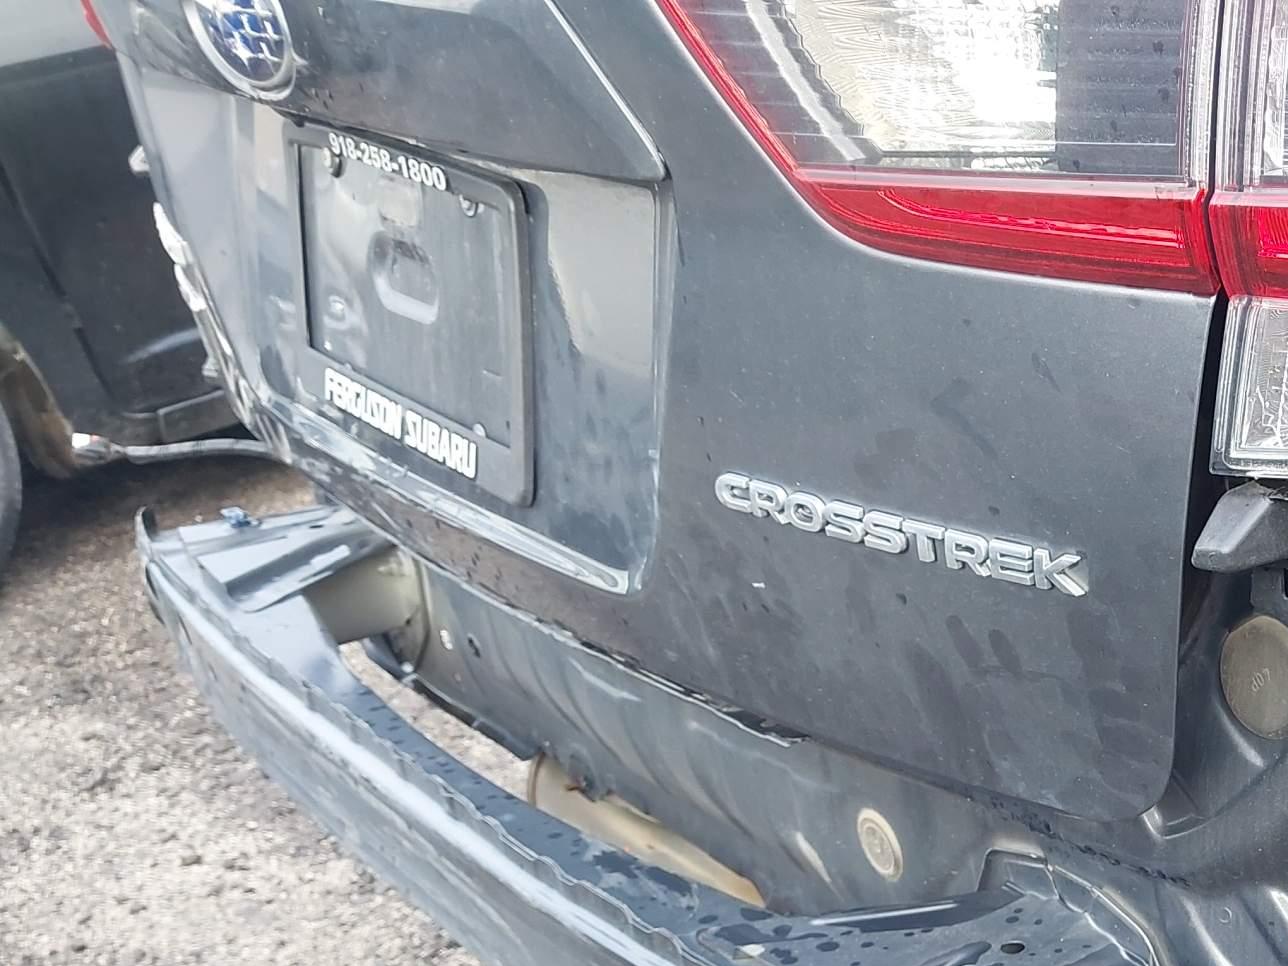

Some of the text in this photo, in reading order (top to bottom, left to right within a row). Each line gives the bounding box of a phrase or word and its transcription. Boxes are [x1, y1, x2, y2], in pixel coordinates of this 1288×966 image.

[328, 132, 447, 191] 918-258-1800
[325, 367, 478, 480] FERGUSON SUBARU
[714, 471, 1090, 598] CROSSTREK
